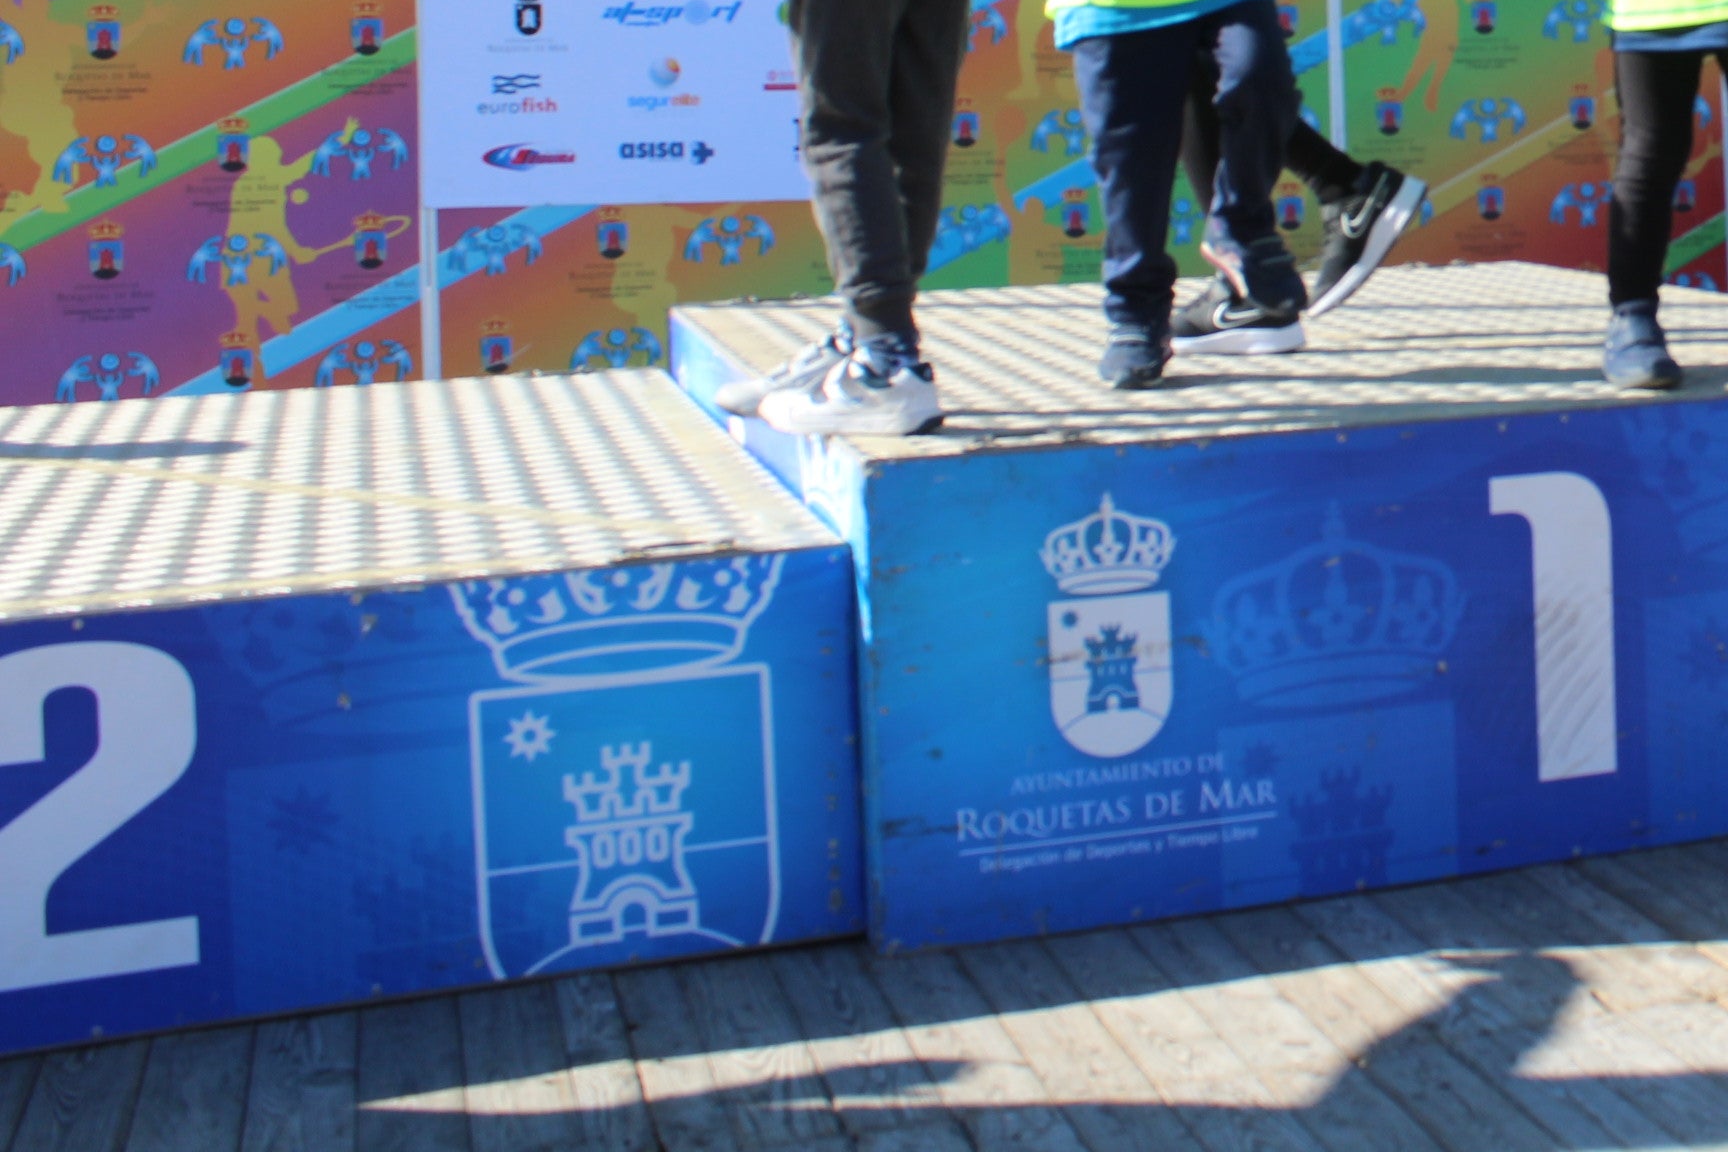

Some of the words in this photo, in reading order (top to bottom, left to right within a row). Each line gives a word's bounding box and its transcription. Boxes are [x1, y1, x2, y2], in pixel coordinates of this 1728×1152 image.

[476, 97, 558, 116] eurofish
[619, 140, 684, 160] asisa
[1488, 470, 1618, 785] 1
[1010, 758, 1192, 795] AYUNTAMIENTO
[1197, 751, 1224, 774] DE
[0, 639, 202, 995] 2
[956, 797, 1131, 842] ROQUETAS
[1144, 789, 1185, 819] DE
[1199, 778, 1277, 813] MAR
[979, 850, 1061, 873] Delegación
[1063, 846, 1083, 862] de
[1086, 839, 1151, 860] Deportes
[1167, 830, 1220, 848] Tiempo
[1222, 825, 1260, 843] Libre
